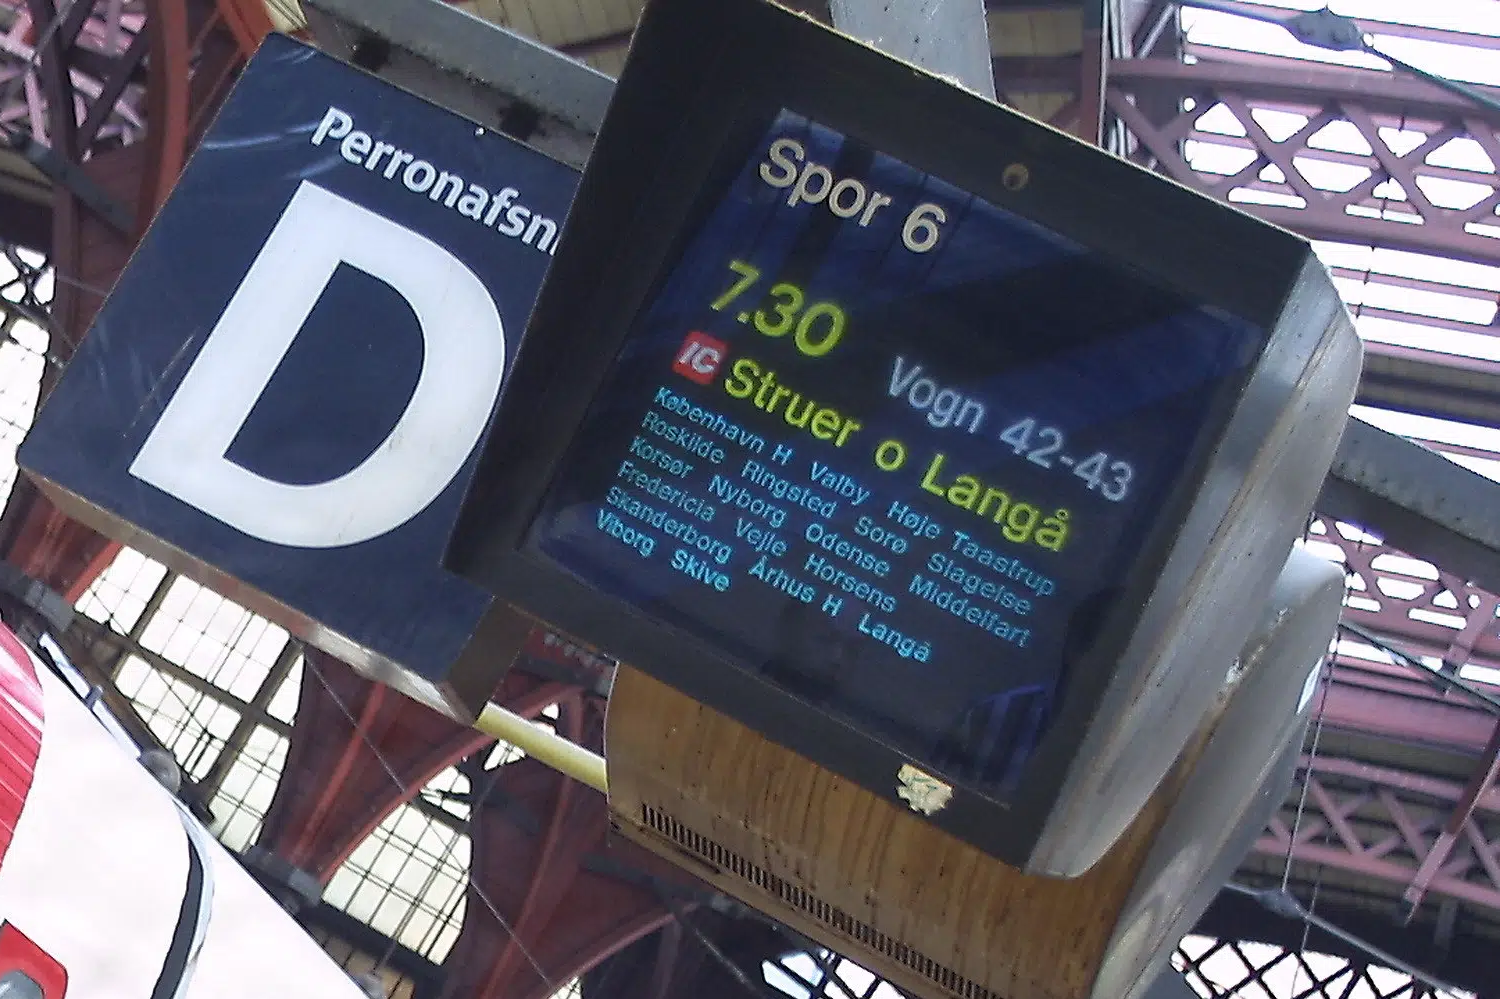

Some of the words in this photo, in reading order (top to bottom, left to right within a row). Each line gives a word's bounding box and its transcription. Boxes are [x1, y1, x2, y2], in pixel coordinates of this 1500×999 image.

[759, 138, 891, 227] Spor
[901, 203, 947, 253] 6
[128, 180, 505, 548] D
[711, 260, 847, 357] 7.30
[641, 411, 725, 464] Roskilde
[741, 460, 839, 519] Ringsted
[927, 552, 1033, 616] Slagelse
[654, 386, 766, 454] København
[771, 443, 794, 466] H
[808, 461, 871, 506] Valby
[951, 529, 1055, 597] Taastrup
[677, 340, 722, 374] IC
[724, 358, 862, 447] Struer
[874, 439, 906, 471] o
[919, 453, 1071, 552] Langå
[888, 356, 986, 434] Vogn
[999, 417, 1133, 501] 42-43
[596, 508, 657, 557] Viborg
[670, 549, 731, 591] Skive
[605, 486, 733, 565] Skanderborg
[748, 555, 816, 603] Århus
[821, 594, 844, 616] H
[856, 612, 932, 663] Langå
[617, 460, 716, 523] Fredericia
[734, 517, 788, 557] Vejle
[803, 553, 897, 614] Horsens
[629, 435, 694, 479] Korsør
[707, 474, 788, 529] Nyborg
[804, 523, 891, 577] Odense
[908, 573, 1032, 648] Middelfart
